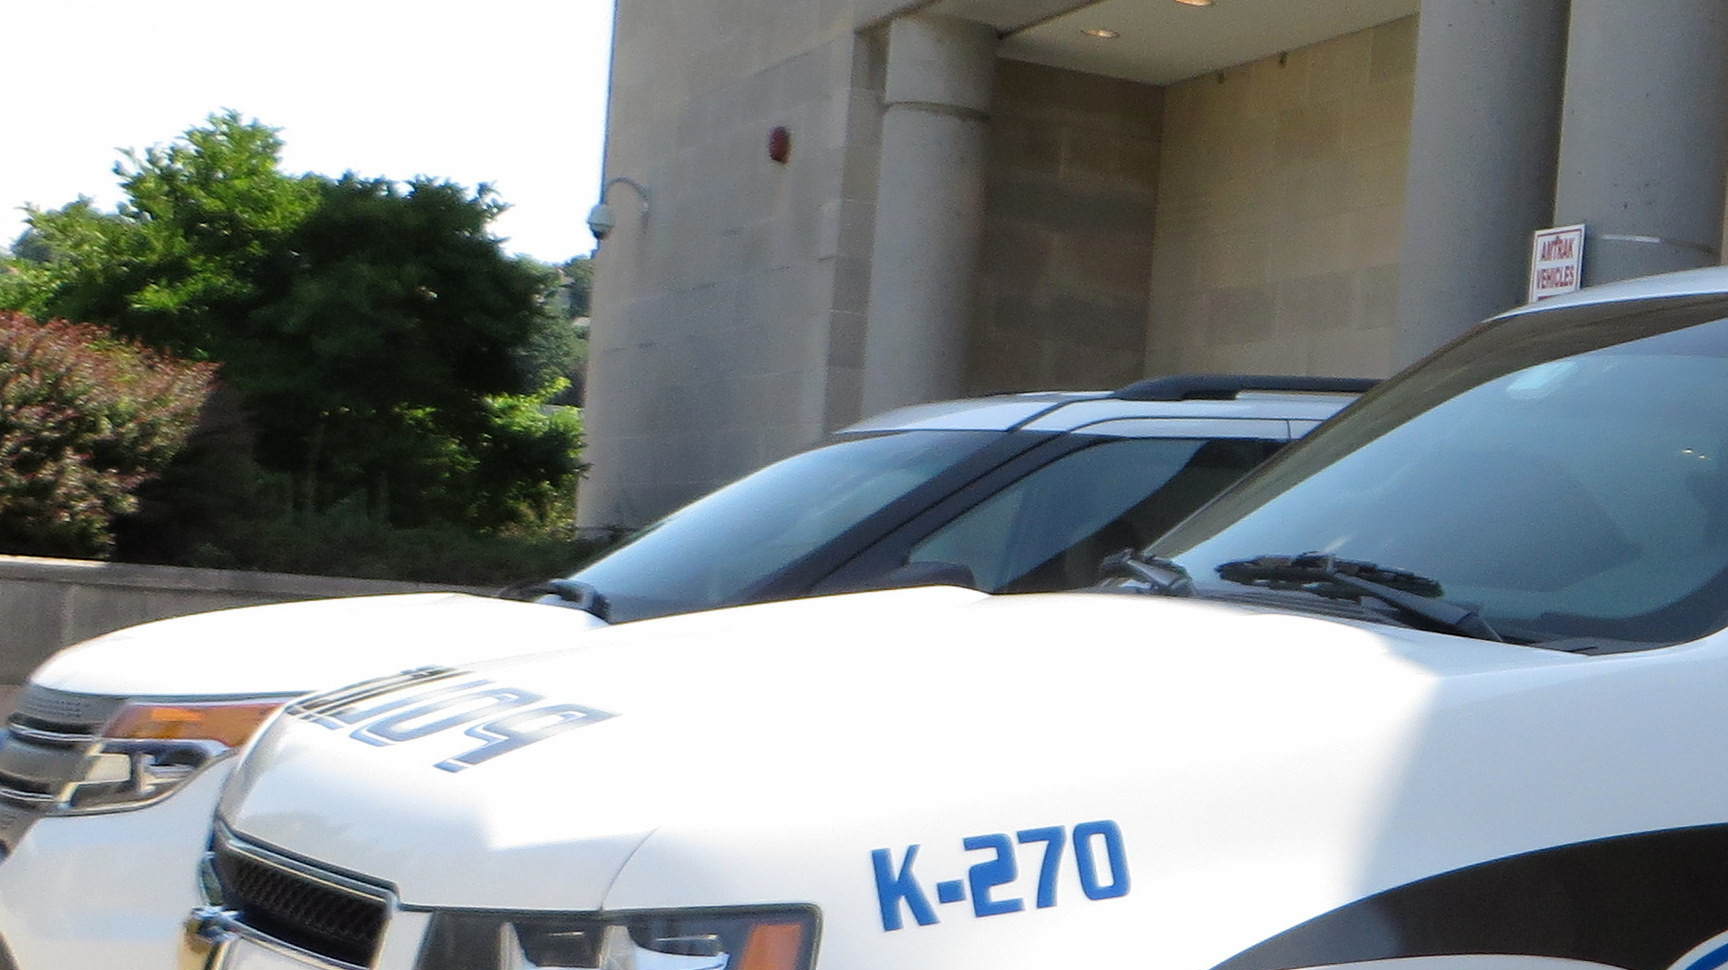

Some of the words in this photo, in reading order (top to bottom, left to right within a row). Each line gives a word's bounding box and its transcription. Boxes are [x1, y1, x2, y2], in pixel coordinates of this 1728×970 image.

[1541, 237, 1575, 261] AMTRAK
[1537, 265, 1574, 288] VEHICLES
[871, 819, 1131, 931] K-270
